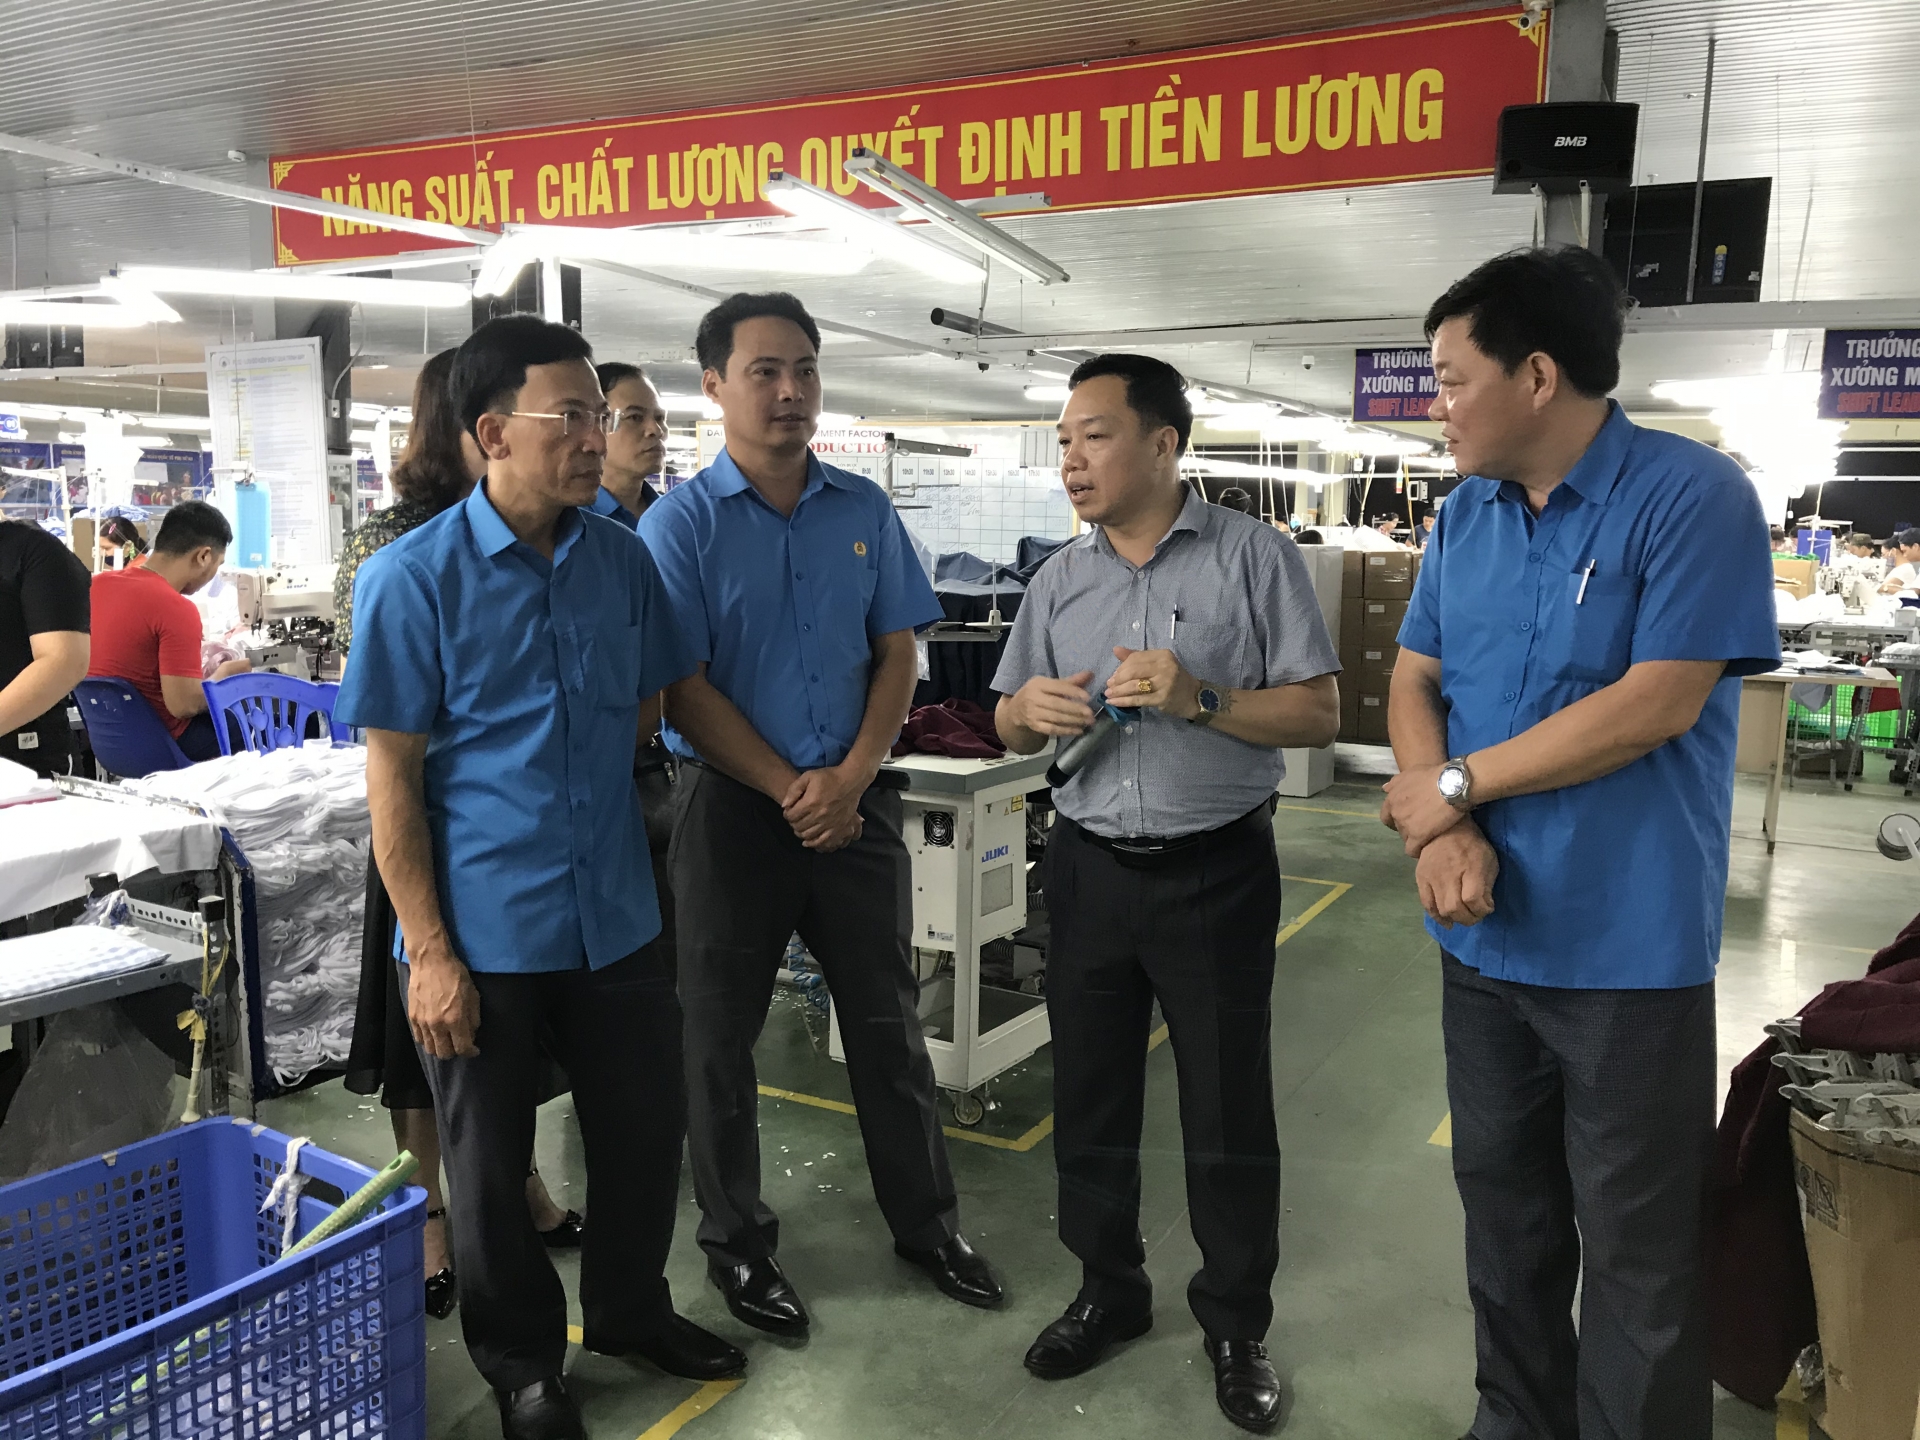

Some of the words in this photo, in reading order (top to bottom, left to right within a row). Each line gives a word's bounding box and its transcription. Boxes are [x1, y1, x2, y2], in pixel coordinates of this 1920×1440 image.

[1554, 136, 1588, 147] BMB
[321, 172, 414, 237] NĂNG
[424, 150, 525, 226] SUẤT,
[537, 138, 634, 220] CHẤT
[647, 141, 784, 220] LƯỢNG
[958, 110, 1082, 197] ĐỊNH
[1100, 74, 1222, 173] TIỀN
[1242, 68, 1445, 159] LƯƠNG
[1846, 331, 1920, 358] TRƯỞNG
[1361, 370, 1415, 393] XƯỞNG
[1830, 359, 1899, 386] XƯỞNG
[1368, 397, 1401, 417] SHIFT
[1882, 392, 1920, 413] LEAD
[814, 429, 846, 437] RMENT
[848, 429, 893, 438] FACTOR
[981, 844, 1009, 863] JUKI
